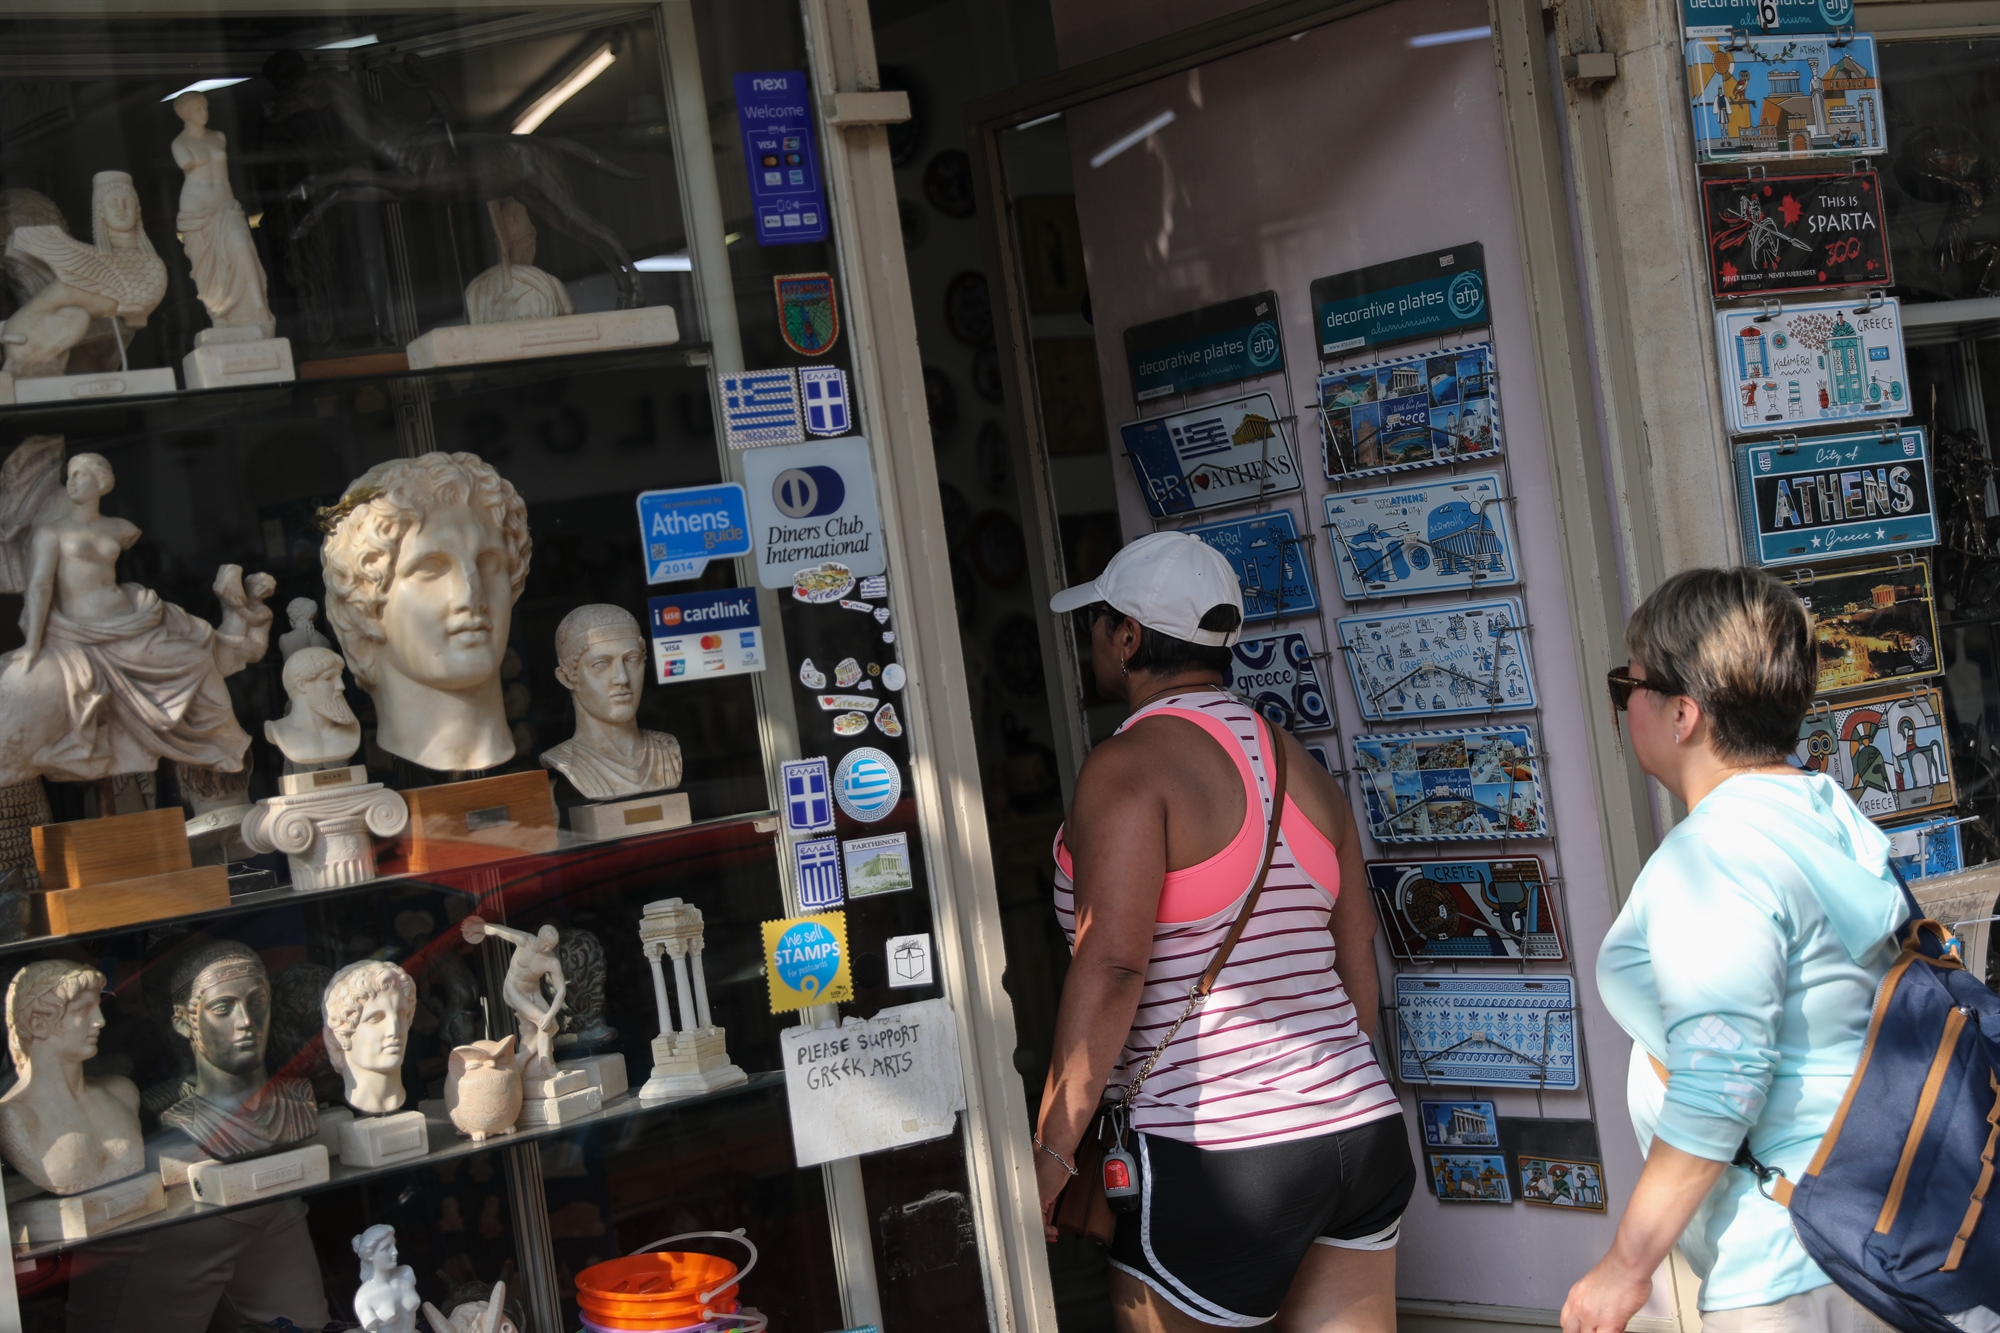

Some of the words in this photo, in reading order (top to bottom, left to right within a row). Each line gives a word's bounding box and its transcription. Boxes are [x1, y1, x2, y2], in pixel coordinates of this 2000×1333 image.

[1761, 0, 1775, 24] 6
[753, 78, 787, 91] nexi
[744, 104, 804, 119] Welcome
[756, 140, 778, 150] VISA
[1818, 195, 1846, 208] THIS
[1849, 196, 1858, 207] IS
[1808, 212, 1875, 233] SPARTA
[1825, 237, 1861, 267] 300
[1723, 274, 1740, 282] NEVER
[1741, 273, 1763, 282] RETREAT
[1768, 271, 1786, 280] NEVER
[1787, 269, 1817, 278] SURRENDER
[1456, 287, 1479, 306] atp
[1326, 301, 1396, 328] decorative
[1398, 290, 1444, 316] plates
[1371, 314, 1440, 336] aluminium
[1857, 317, 1893, 332] GREECE
[1253, 337, 1274, 354] atp
[1139, 350, 1201, 376] decorative
[1203, 340, 1244, 364] plates
[1179, 363, 1241, 383] aluminium
[1405, 402, 1416, 411] love
[1416, 399, 1428, 411] from
[1816, 449, 1842, 465] City
[1846, 446, 1858, 461] of
[1211, 455, 1291, 489] ATHENS
[1147, 475, 1186, 502] GR
[1775, 466, 1914, 528] ATHENS
[662, 498, 712, 510] recommended
[713, 495, 722, 506] by
[652, 510, 730, 537] Athens
[767, 524, 820, 545] Diners
[825, 515, 864, 538] Club
[703, 524, 744, 549] guide
[1825, 529, 1871, 550] Greece
[765, 533, 869, 565] International
[664, 562, 694, 574] 2014
[807, 579, 854, 602] Greece
[655, 609, 660, 626] i
[664, 611, 680, 621] use
[683, 600, 749, 622] cardlink
[848, 601, 871, 612] Greece
[664, 645, 680, 653] VISA
[1237, 670, 1293, 696] greece
[833, 696, 874, 708] Greece
[1859, 797, 1892, 814] GREECE
[852, 836, 899, 850] PARTHENON
[1434, 865, 1475, 881] CRETE
[784, 928, 803, 948] We
[804, 923, 823, 943] sell
[773, 941, 841, 966] STAMPS
[787, 968, 798, 978] for
[799, 960, 828, 977] postcards
[1414, 997, 1450, 1008] GREECE
[797, 1037, 850, 1065] PLEASE
[857, 1024, 919, 1050] SUPPORT
[1517, 1053, 1556, 1066] GREECE
[807, 1056, 866, 1090] GREEK
[870, 1051, 913, 1078] ARTS
